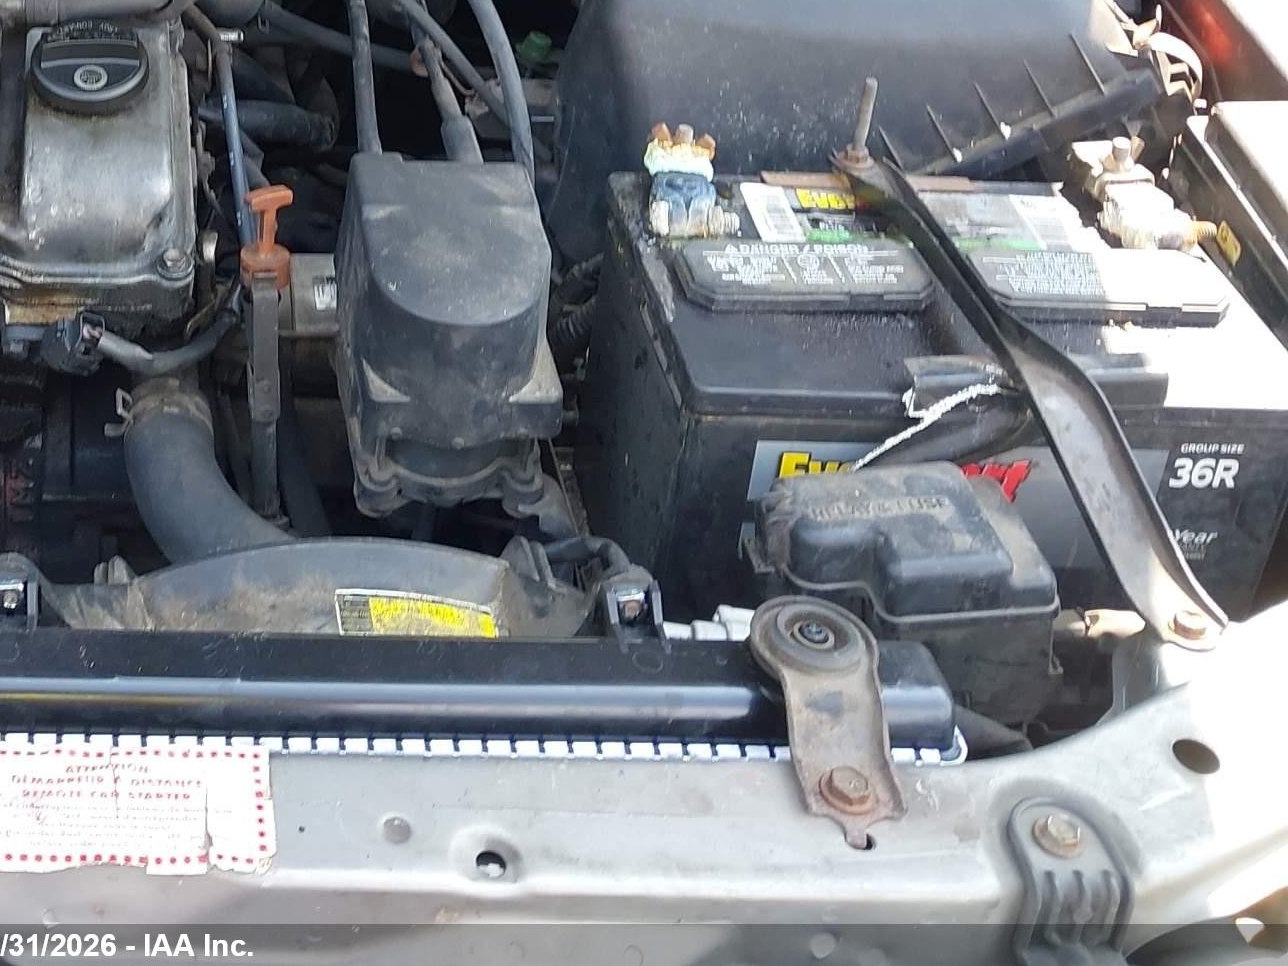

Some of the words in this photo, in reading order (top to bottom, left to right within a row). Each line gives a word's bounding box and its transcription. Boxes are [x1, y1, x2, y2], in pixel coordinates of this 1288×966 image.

[1180, 442, 1220, 455] GROUP
[1220, 443, 1245, 455] SIZE
[1168, 457, 1240, 489] 36R
